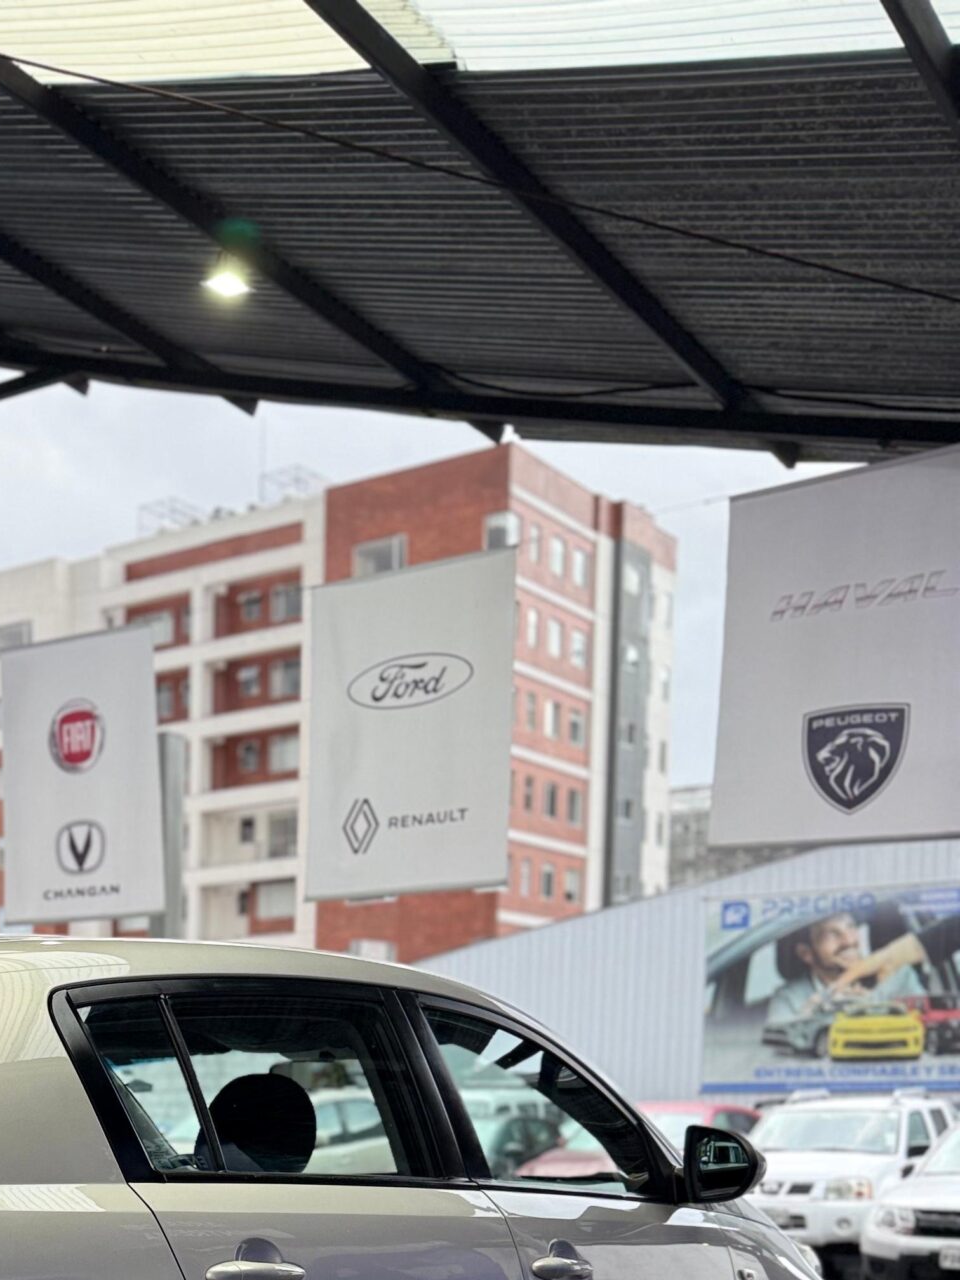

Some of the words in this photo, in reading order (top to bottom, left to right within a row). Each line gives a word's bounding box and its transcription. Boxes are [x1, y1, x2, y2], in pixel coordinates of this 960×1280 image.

[371, 661, 448, 703] Ford
[811, 712, 900, 731] PEUGEOT
[61, 719, 95, 755] FIAT
[388, 807, 470, 830] RENAULT
[42, 883, 121, 902] CHANGAN
